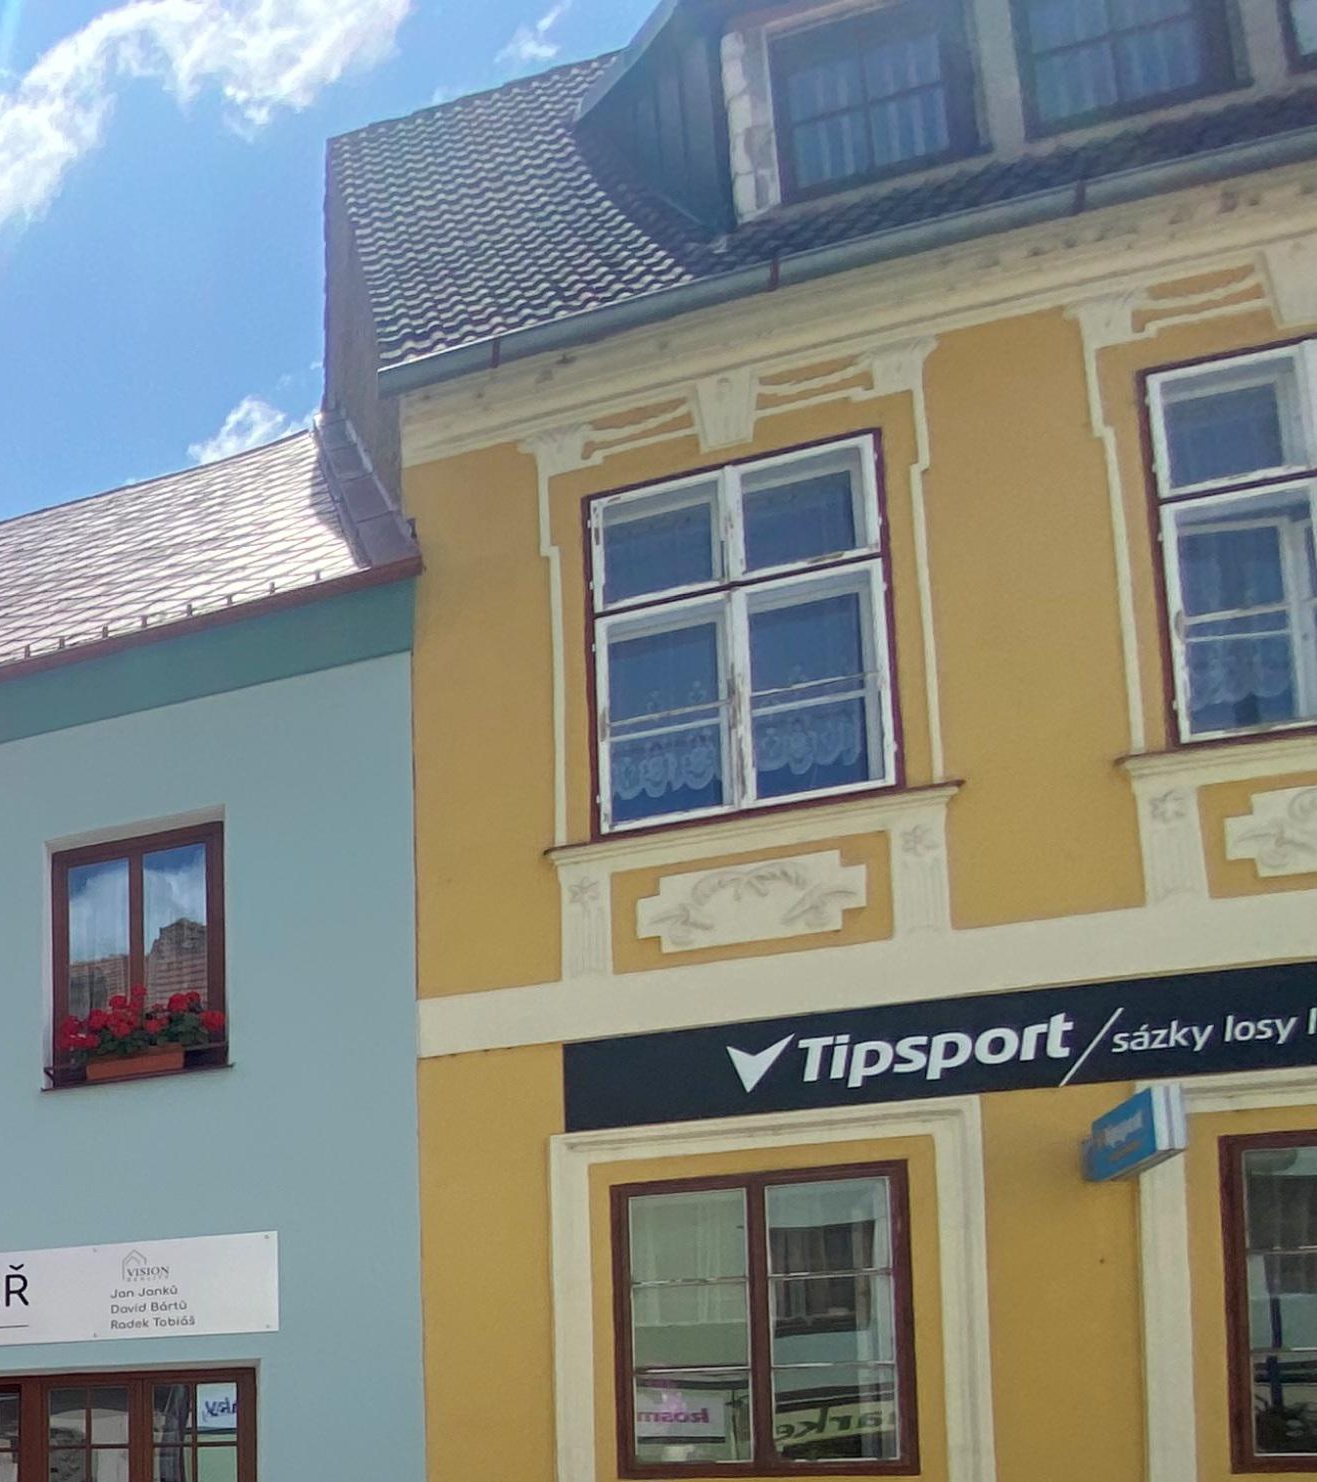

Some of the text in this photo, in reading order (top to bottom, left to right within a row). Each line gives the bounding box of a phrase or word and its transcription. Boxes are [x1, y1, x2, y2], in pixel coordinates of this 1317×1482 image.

[1112, 1020, 1214, 1052] sázky
[1224, 1015, 1298, 1044] losy
[798, 1012, 1073, 1088] Tipsport
[126, 1266, 169, 1277] VISION
[110, 1285, 178, 1299] Jan Janků
[110, 1303, 146, 1314] David
[111, 1315, 195, 1329] Radek Tobiáš
